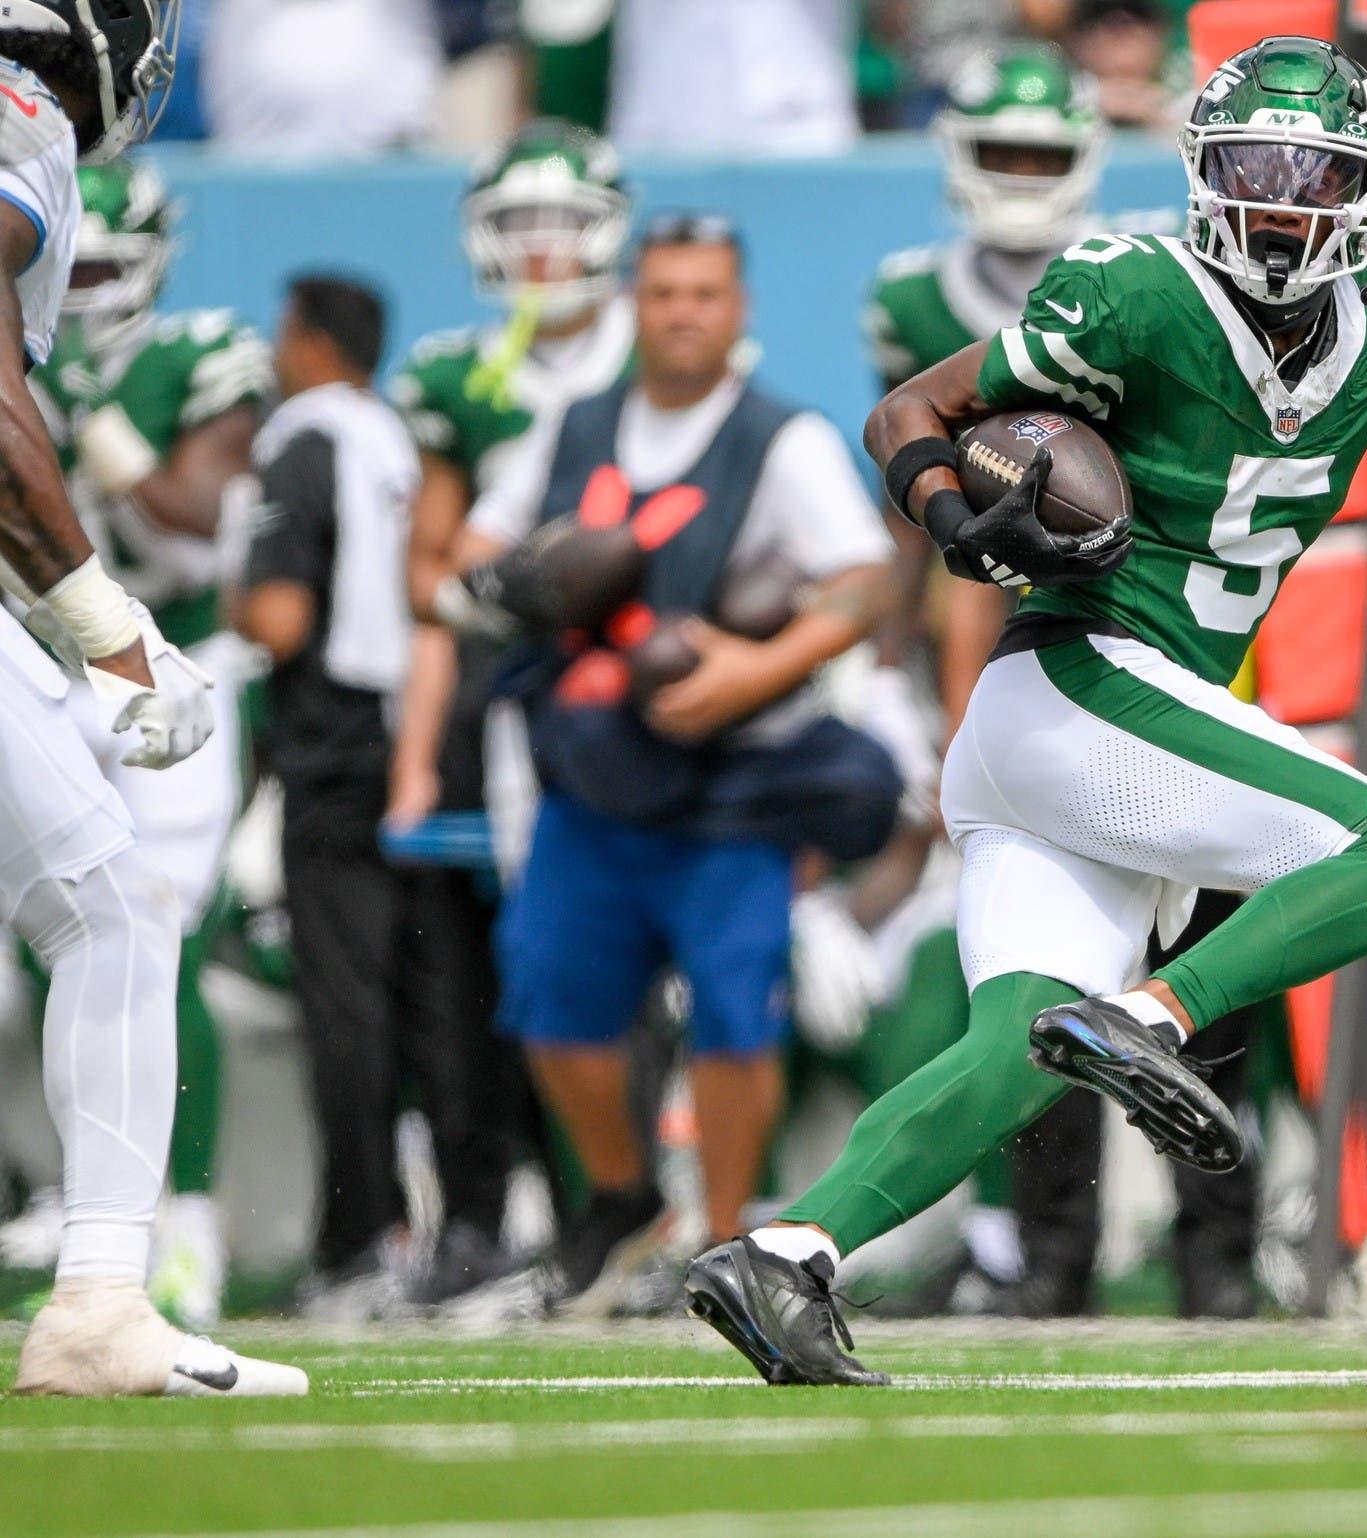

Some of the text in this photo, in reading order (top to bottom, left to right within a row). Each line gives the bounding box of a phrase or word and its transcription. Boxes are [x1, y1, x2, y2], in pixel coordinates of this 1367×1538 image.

[1265, 113, 1305, 126] NY
[1279, 419, 1298, 432] NFL
[1079, 530, 1115, 552] ADIZERO
[1183, 453, 1336, 634] 5
